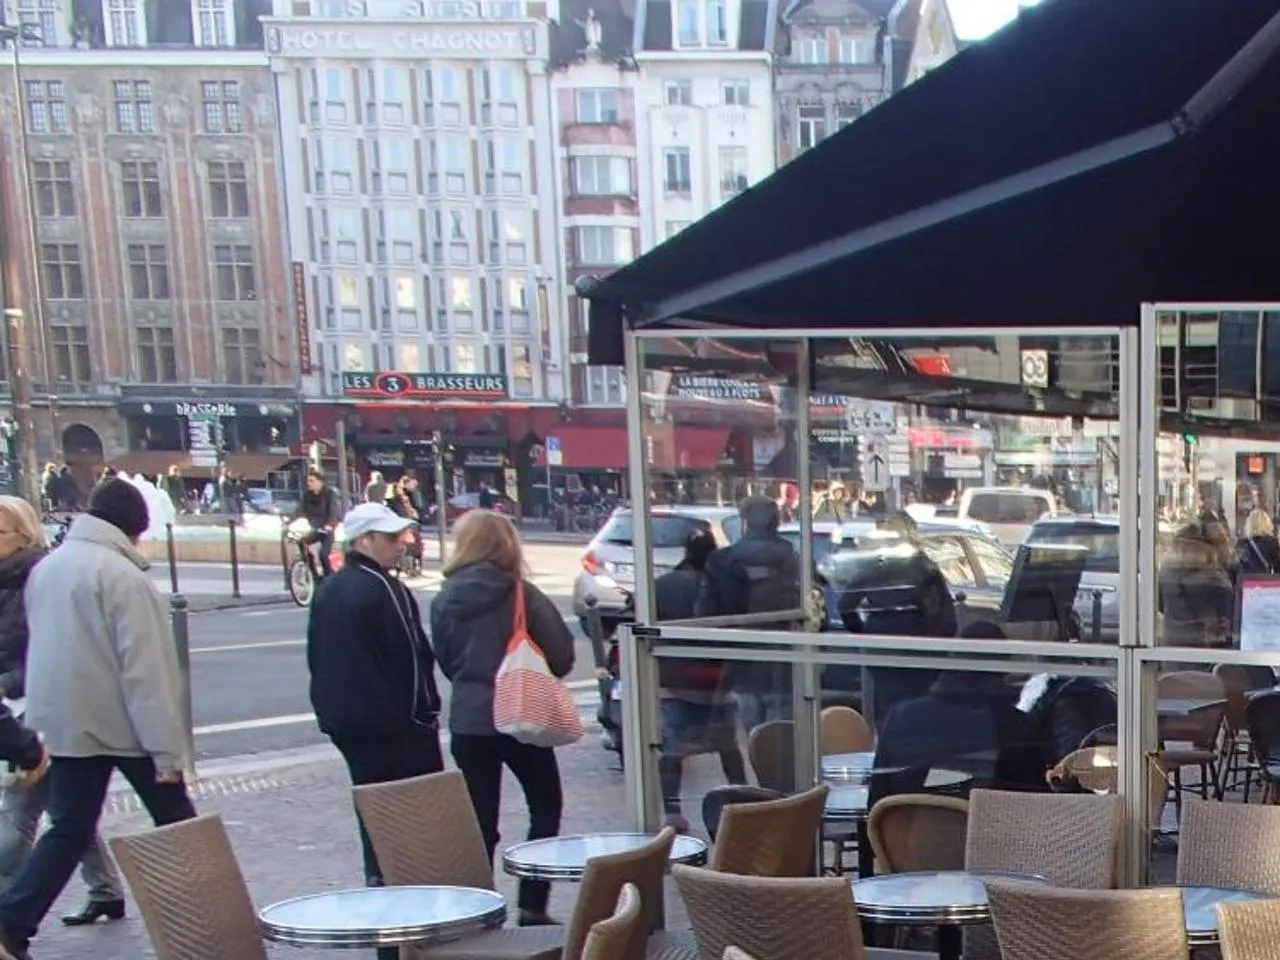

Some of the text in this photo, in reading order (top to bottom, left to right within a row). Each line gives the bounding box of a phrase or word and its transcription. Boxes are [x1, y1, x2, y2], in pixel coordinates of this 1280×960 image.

[284, 31, 519, 50] HOTEL CHAGNOT
[344, 376, 504, 392] LES 3 BRASSEURS
